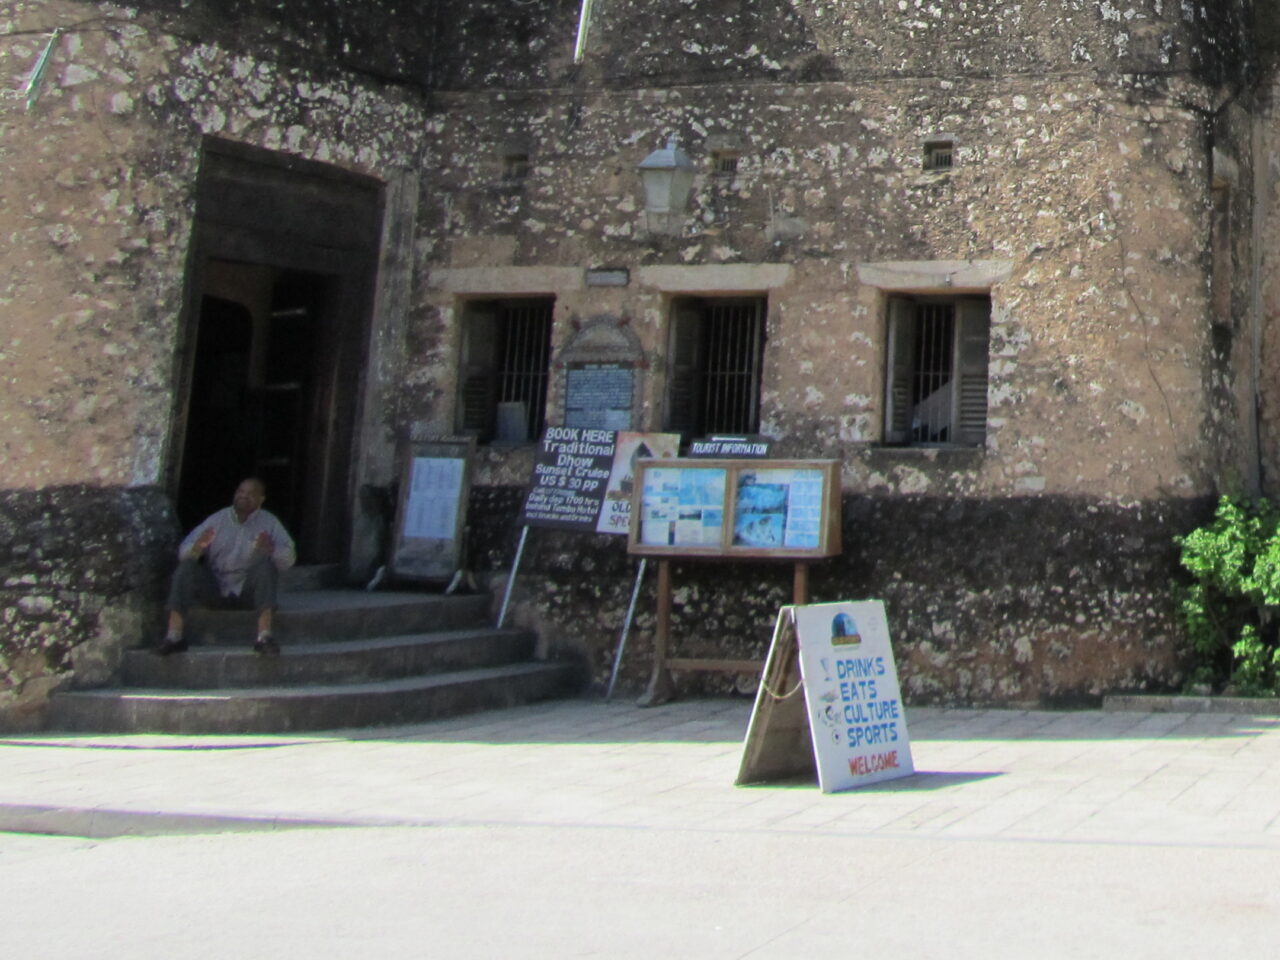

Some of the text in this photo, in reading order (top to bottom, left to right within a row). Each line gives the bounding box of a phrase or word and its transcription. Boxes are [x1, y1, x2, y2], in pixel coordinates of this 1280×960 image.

[546, 427, 614, 442] BOOK HERE
[544, 440, 615, 456] Traditional
[692, 442, 768, 455] TOURIST INFORMATION
[557, 454, 594, 468] Dhow
[536, 464, 610, 479] Sunset Cruise
[540, 476, 556, 486] US
[558, 477, 566, 486] $
[568, 478, 581, 489] 30
[528, 493, 547, 503] Daily
[609, 515, 631, 528] SPE
[836, 657, 885, 679] DRINKS
[840, 680, 877, 702] EATS
[843, 700, 899, 724] CULTURE
[847, 722, 898, 748] SPORTS
[848, 750, 899, 776] WELCOME
